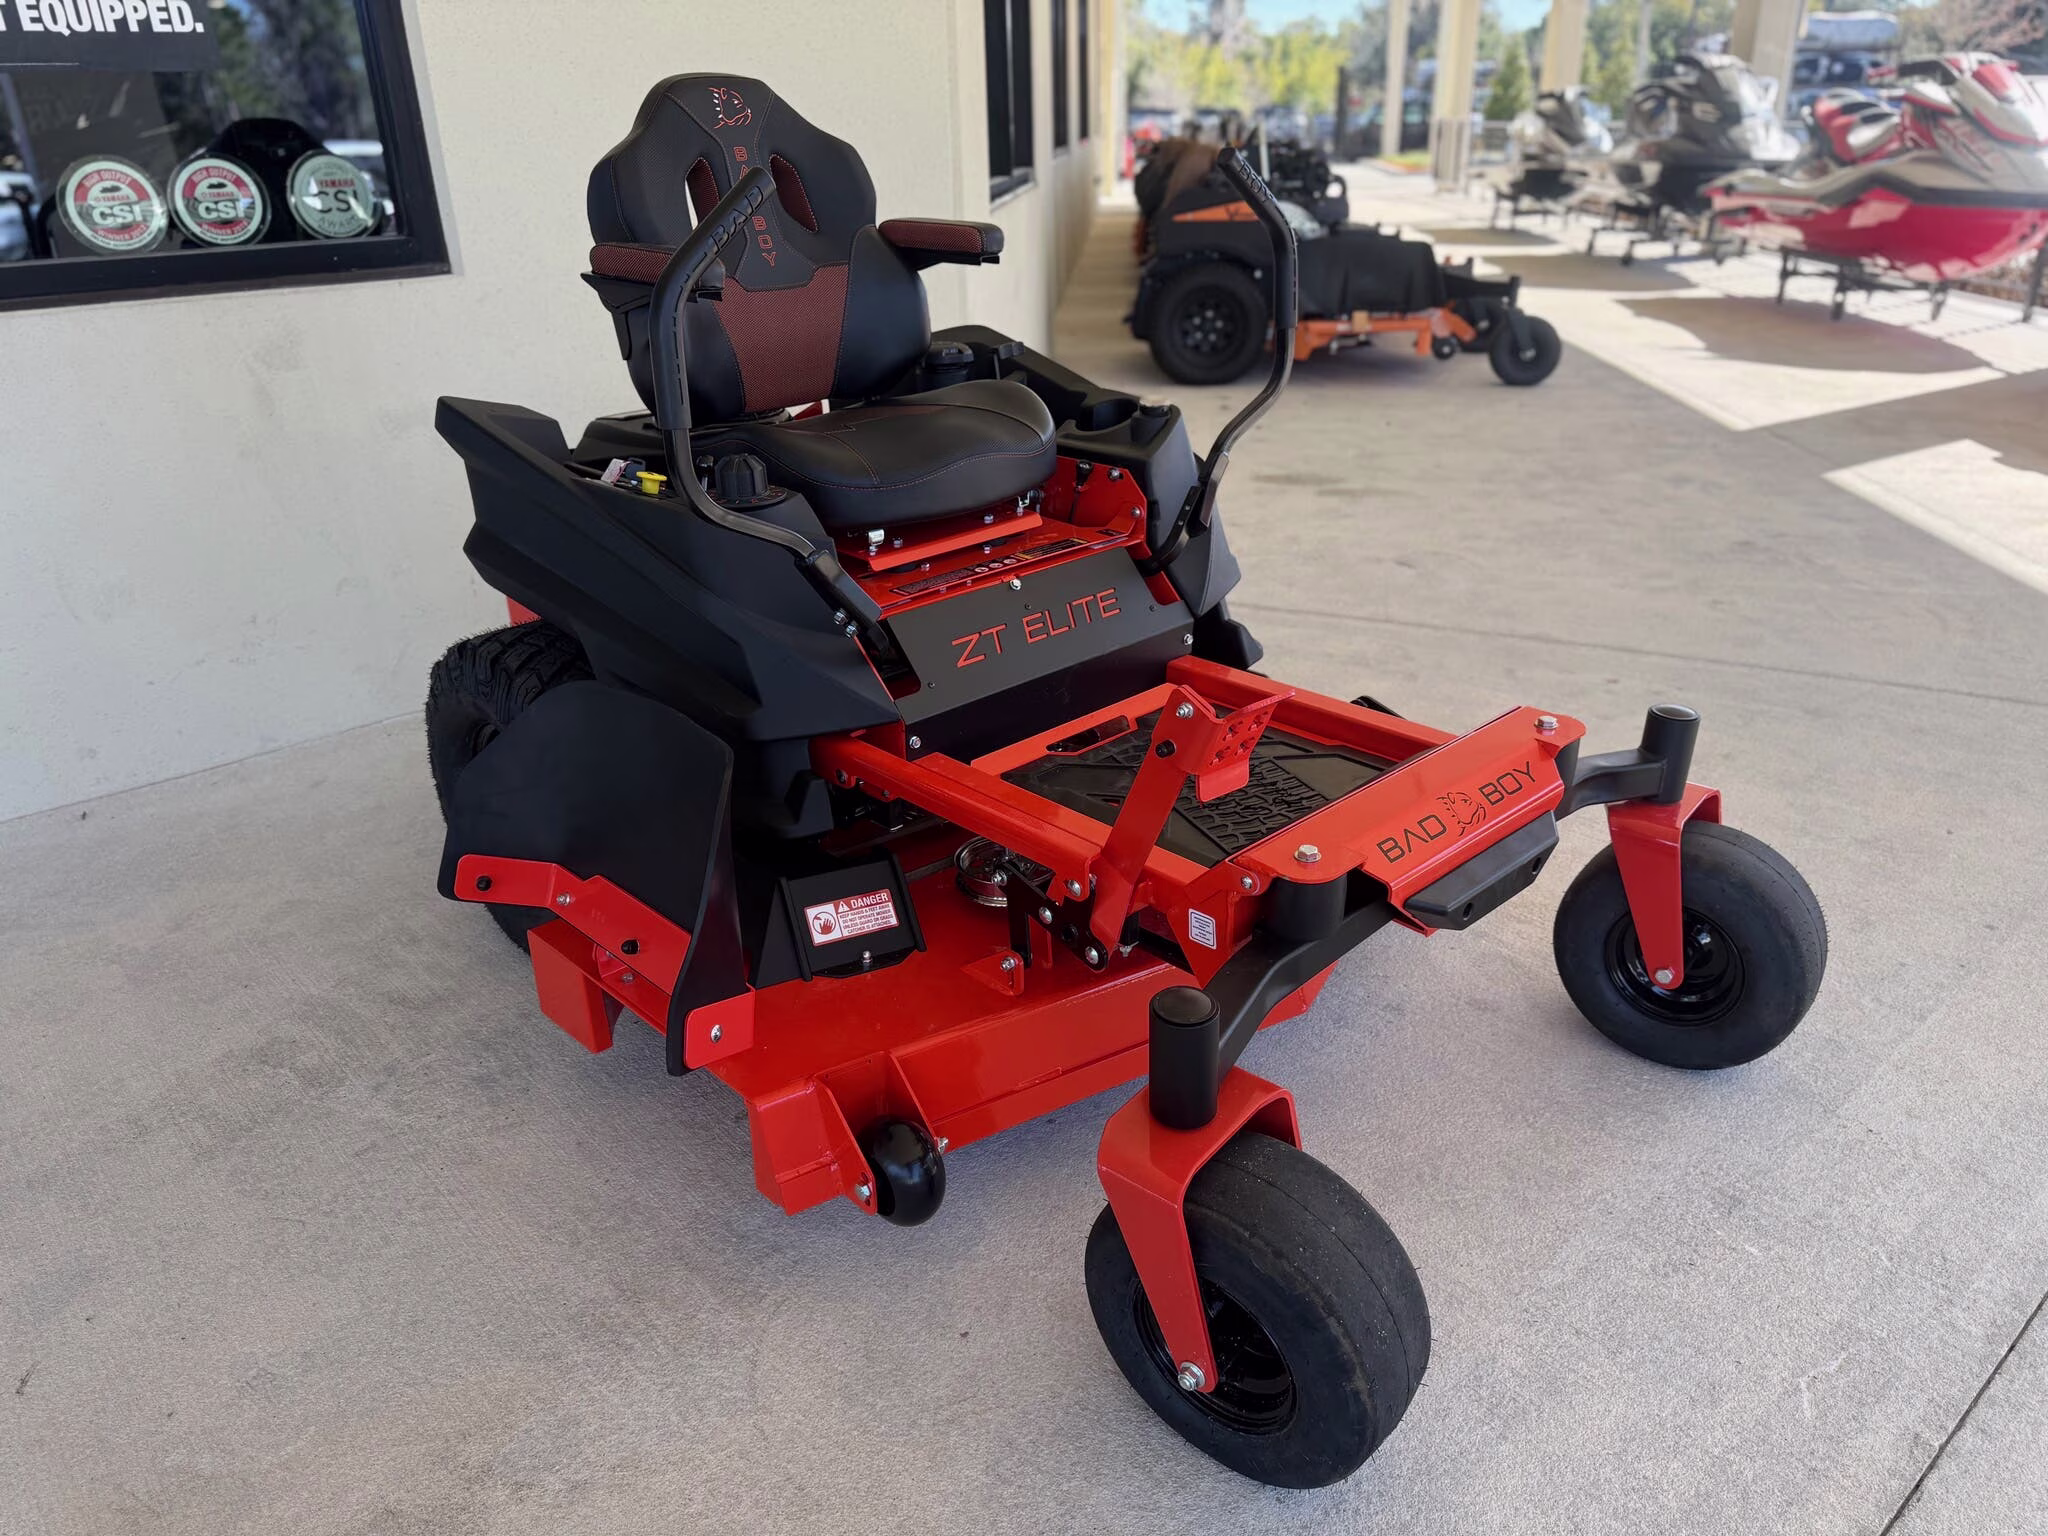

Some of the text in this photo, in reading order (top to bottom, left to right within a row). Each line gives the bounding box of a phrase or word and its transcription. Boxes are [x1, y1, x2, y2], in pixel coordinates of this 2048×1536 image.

[16, 0, 205, 37] EQUIPPED.
[319, 178, 356, 188] YAMAHA
[198, 200, 245, 219] CSI
[311, 190, 359, 213] CSI
[92, 204, 142, 225] CSI
[752, 216, 777, 266] BOY
[952, 587, 1122, 668] ZT ELITE
[1376, 761, 1536, 864] BAD BOY
[850, 892, 888, 909] DANGER
